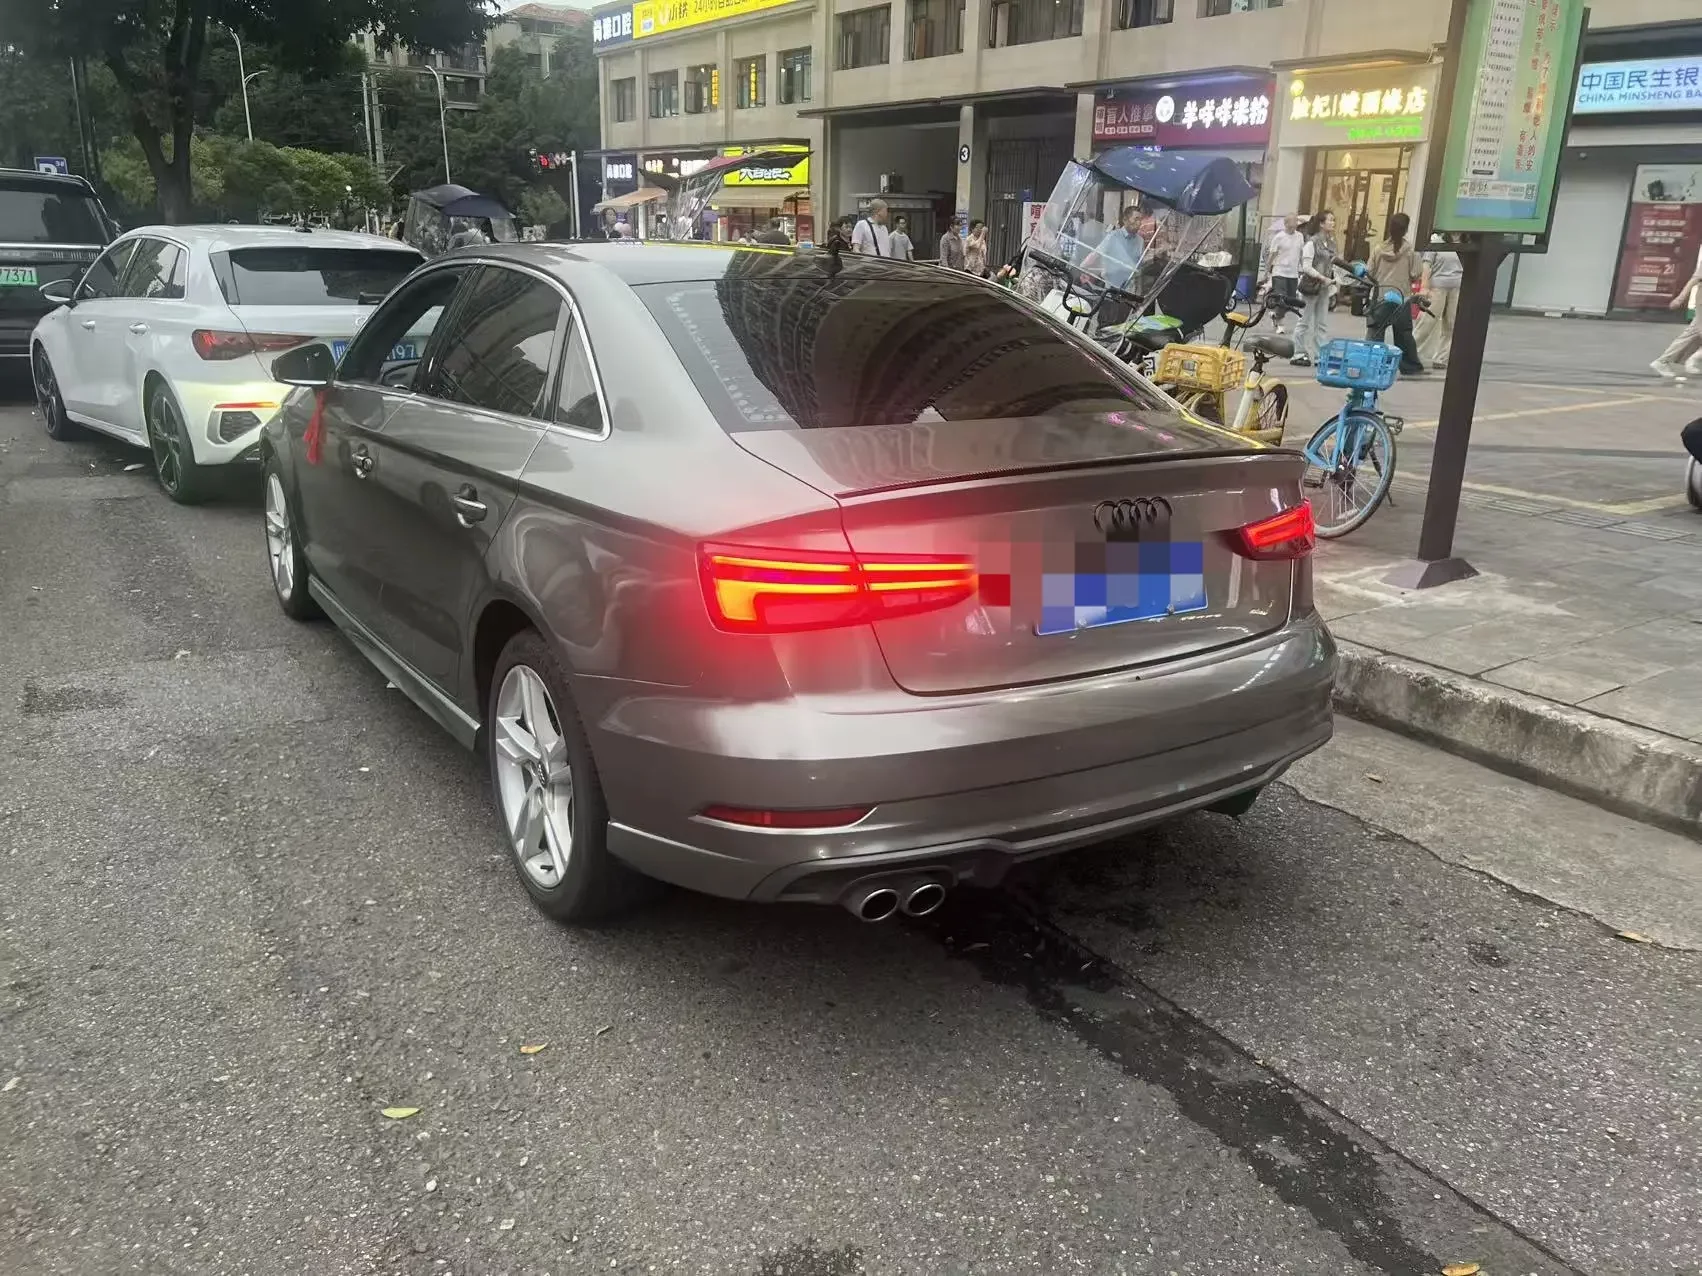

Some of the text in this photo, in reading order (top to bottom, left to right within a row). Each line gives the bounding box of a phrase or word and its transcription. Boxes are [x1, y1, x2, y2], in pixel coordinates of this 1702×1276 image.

[1581, 67, 1700, 90] 中国民生银
[1579, 92, 1614, 103] CHINA
[1619, 90, 1681, 102] MINSHENG
[1106, 104, 1154, 124] 盲人推拿
[1182, 95, 1270, 129] 羊咩咩米粉
[960, 146, 969, 161] 3
